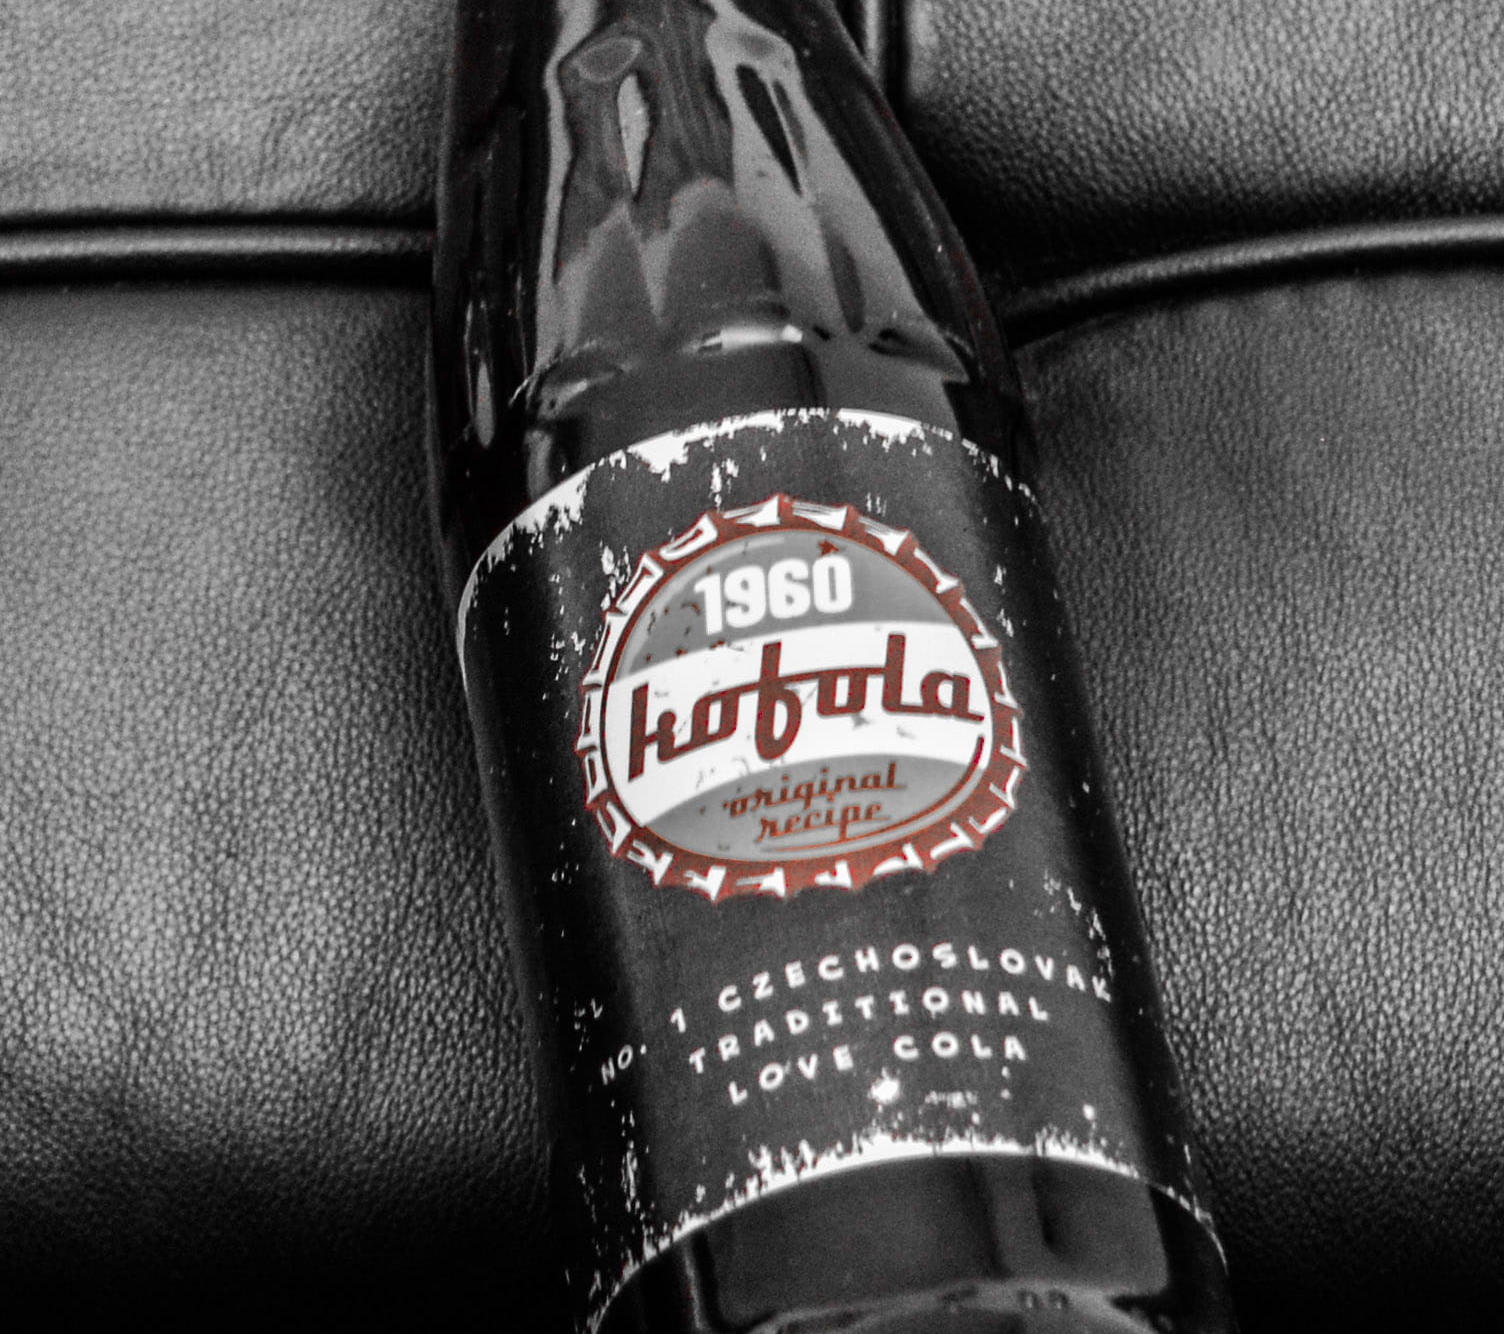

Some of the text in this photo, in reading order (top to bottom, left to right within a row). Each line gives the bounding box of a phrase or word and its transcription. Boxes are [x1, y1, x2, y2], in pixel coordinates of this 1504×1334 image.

[694, 553, 854, 636] 1960
[627, 632, 985, 784] kofola
[722, 761, 908, 817] original
[755, 800, 890, 843] recipe
[600, 942, 1112, 1086] NO. 1 CZECHOSLOVAK
[689, 984, 1049, 1075] TRADITIONAL
[728, 1030, 1026, 1107] LOVE COLA
